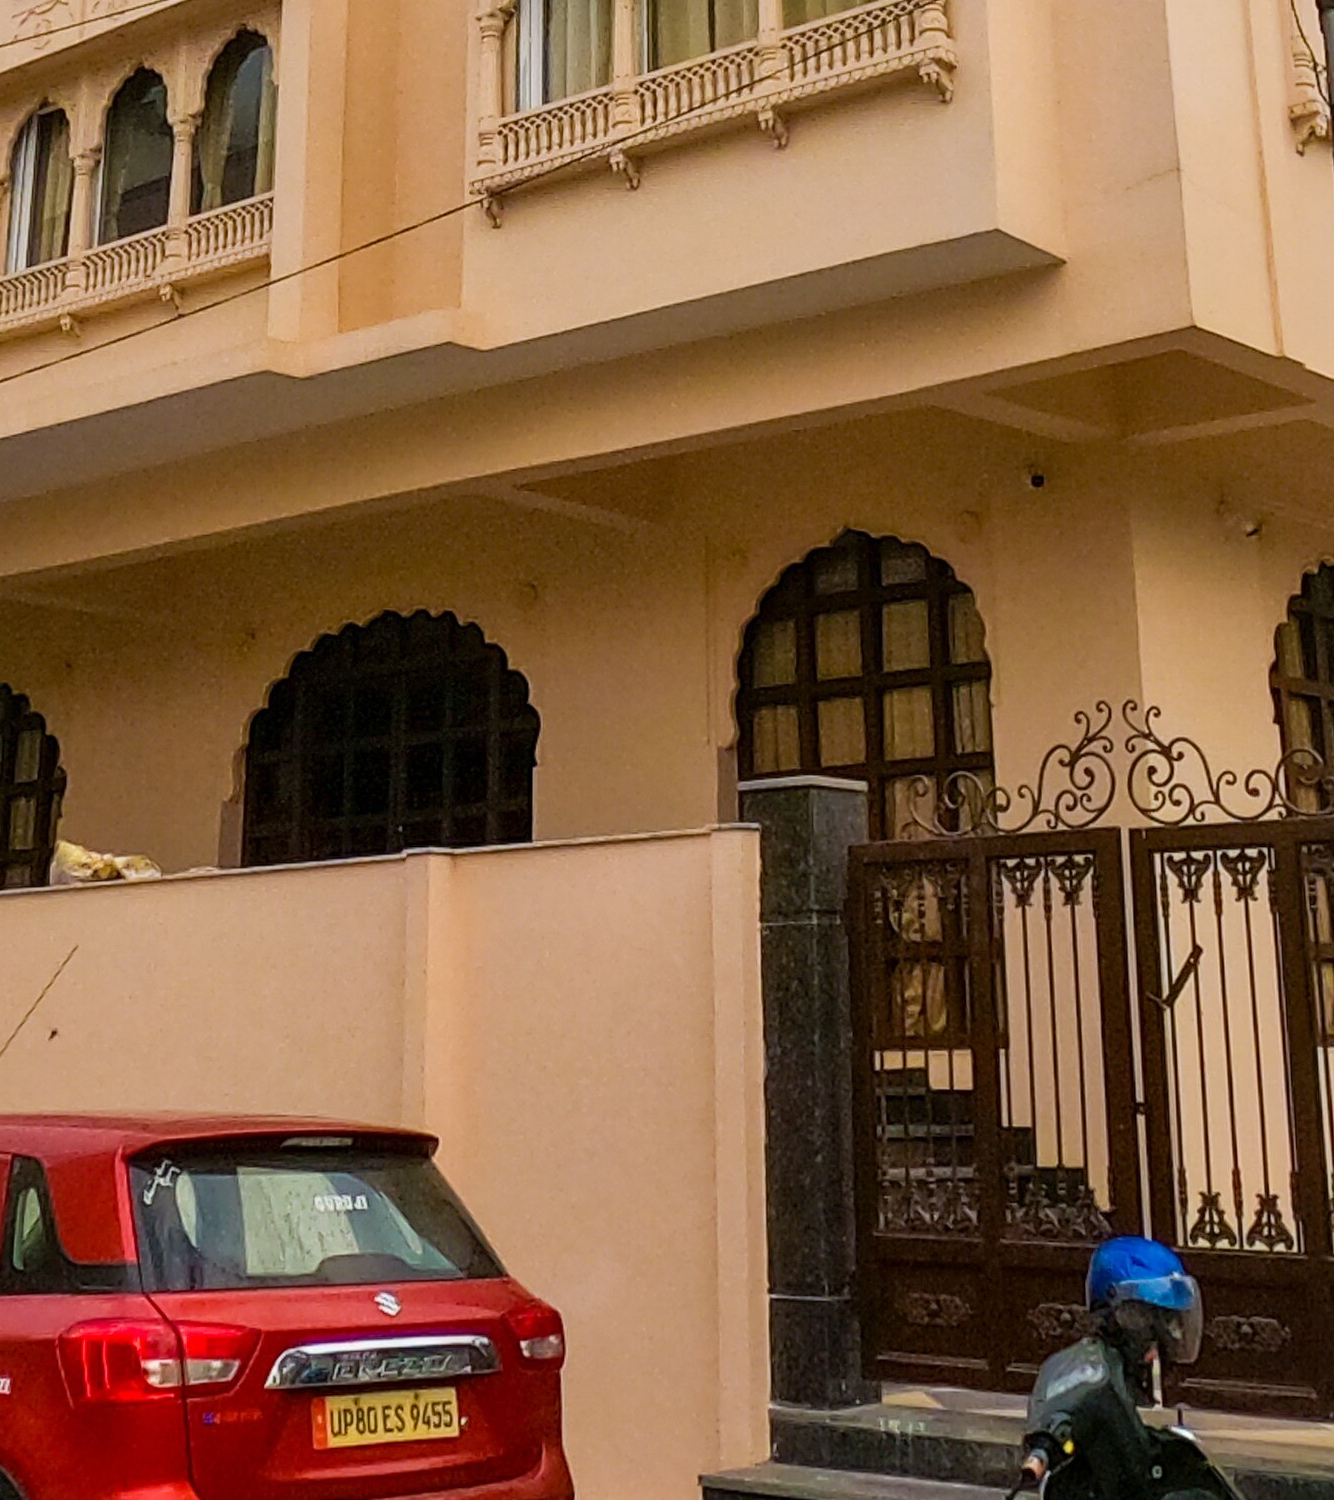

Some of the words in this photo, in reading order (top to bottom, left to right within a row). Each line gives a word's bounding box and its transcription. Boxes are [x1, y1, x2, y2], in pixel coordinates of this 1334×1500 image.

[329, 1406, 378, 1437] UP80
[382, 1404, 406, 1433] ES
[409, 1401, 454, 1431] 9455
